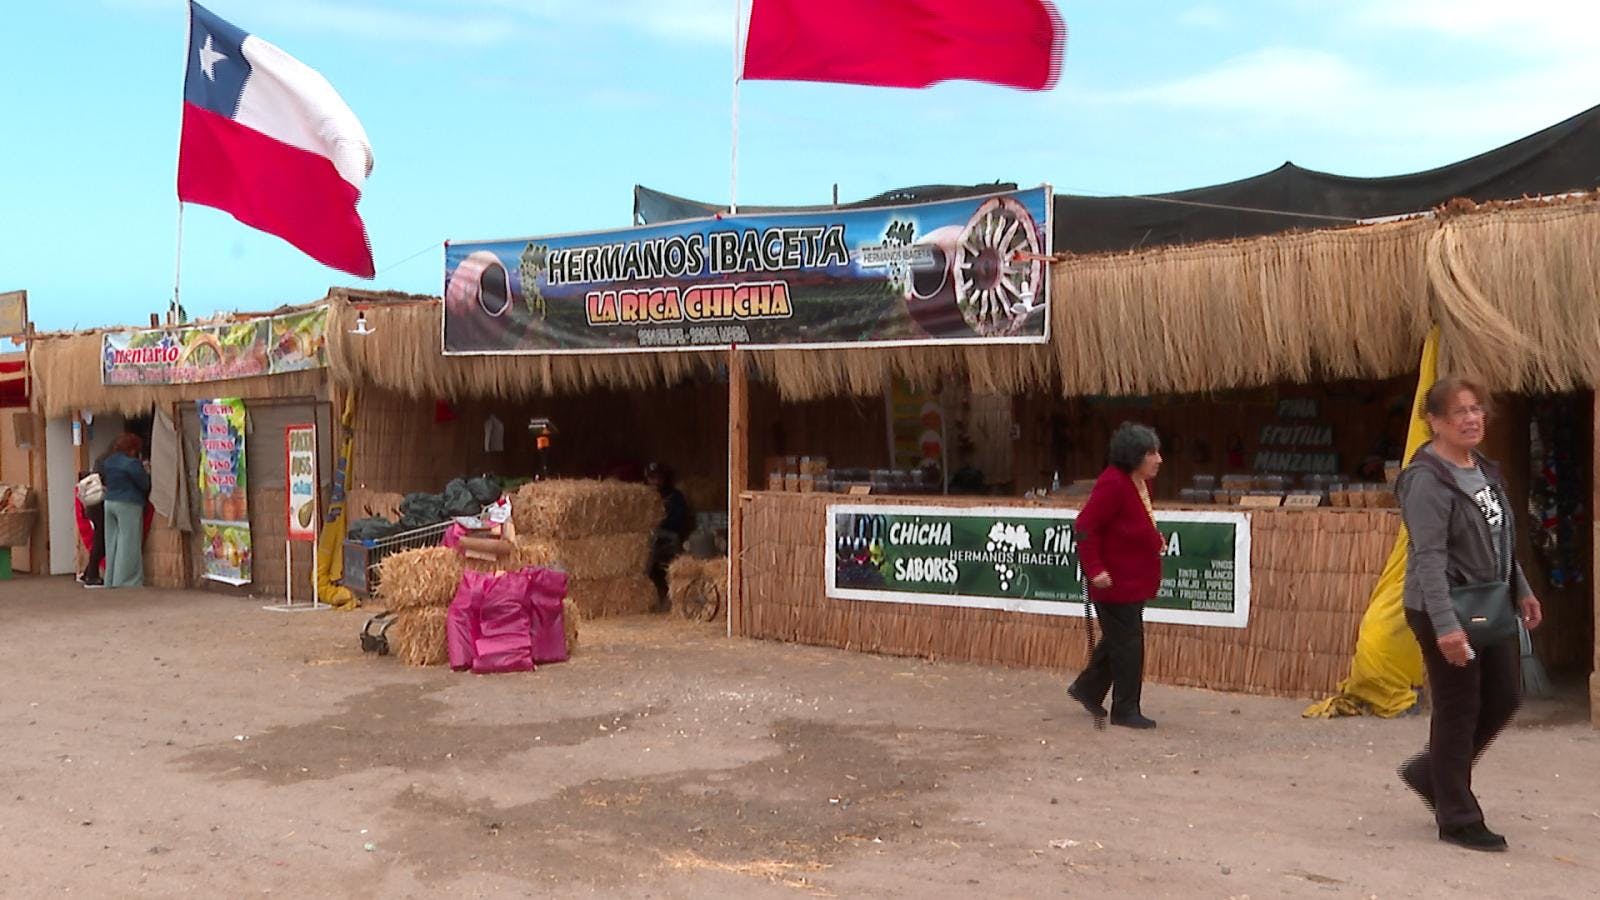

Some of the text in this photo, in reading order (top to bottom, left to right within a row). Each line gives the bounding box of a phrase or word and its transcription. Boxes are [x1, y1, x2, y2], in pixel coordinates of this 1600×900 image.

[547, 226, 849, 285] HERMANOS IBACETA
[586, 282, 793, 326] LA RICA CHICHA
[1254, 451, 1337, 473] MANZANA
[949, 550, 1070, 566] HERMANOS IBACETA
[1211, 560, 1233, 570] VINOS
[895, 558, 958, 584] SABORES
[1179, 568, 1233, 580] TINTO BLANCO
